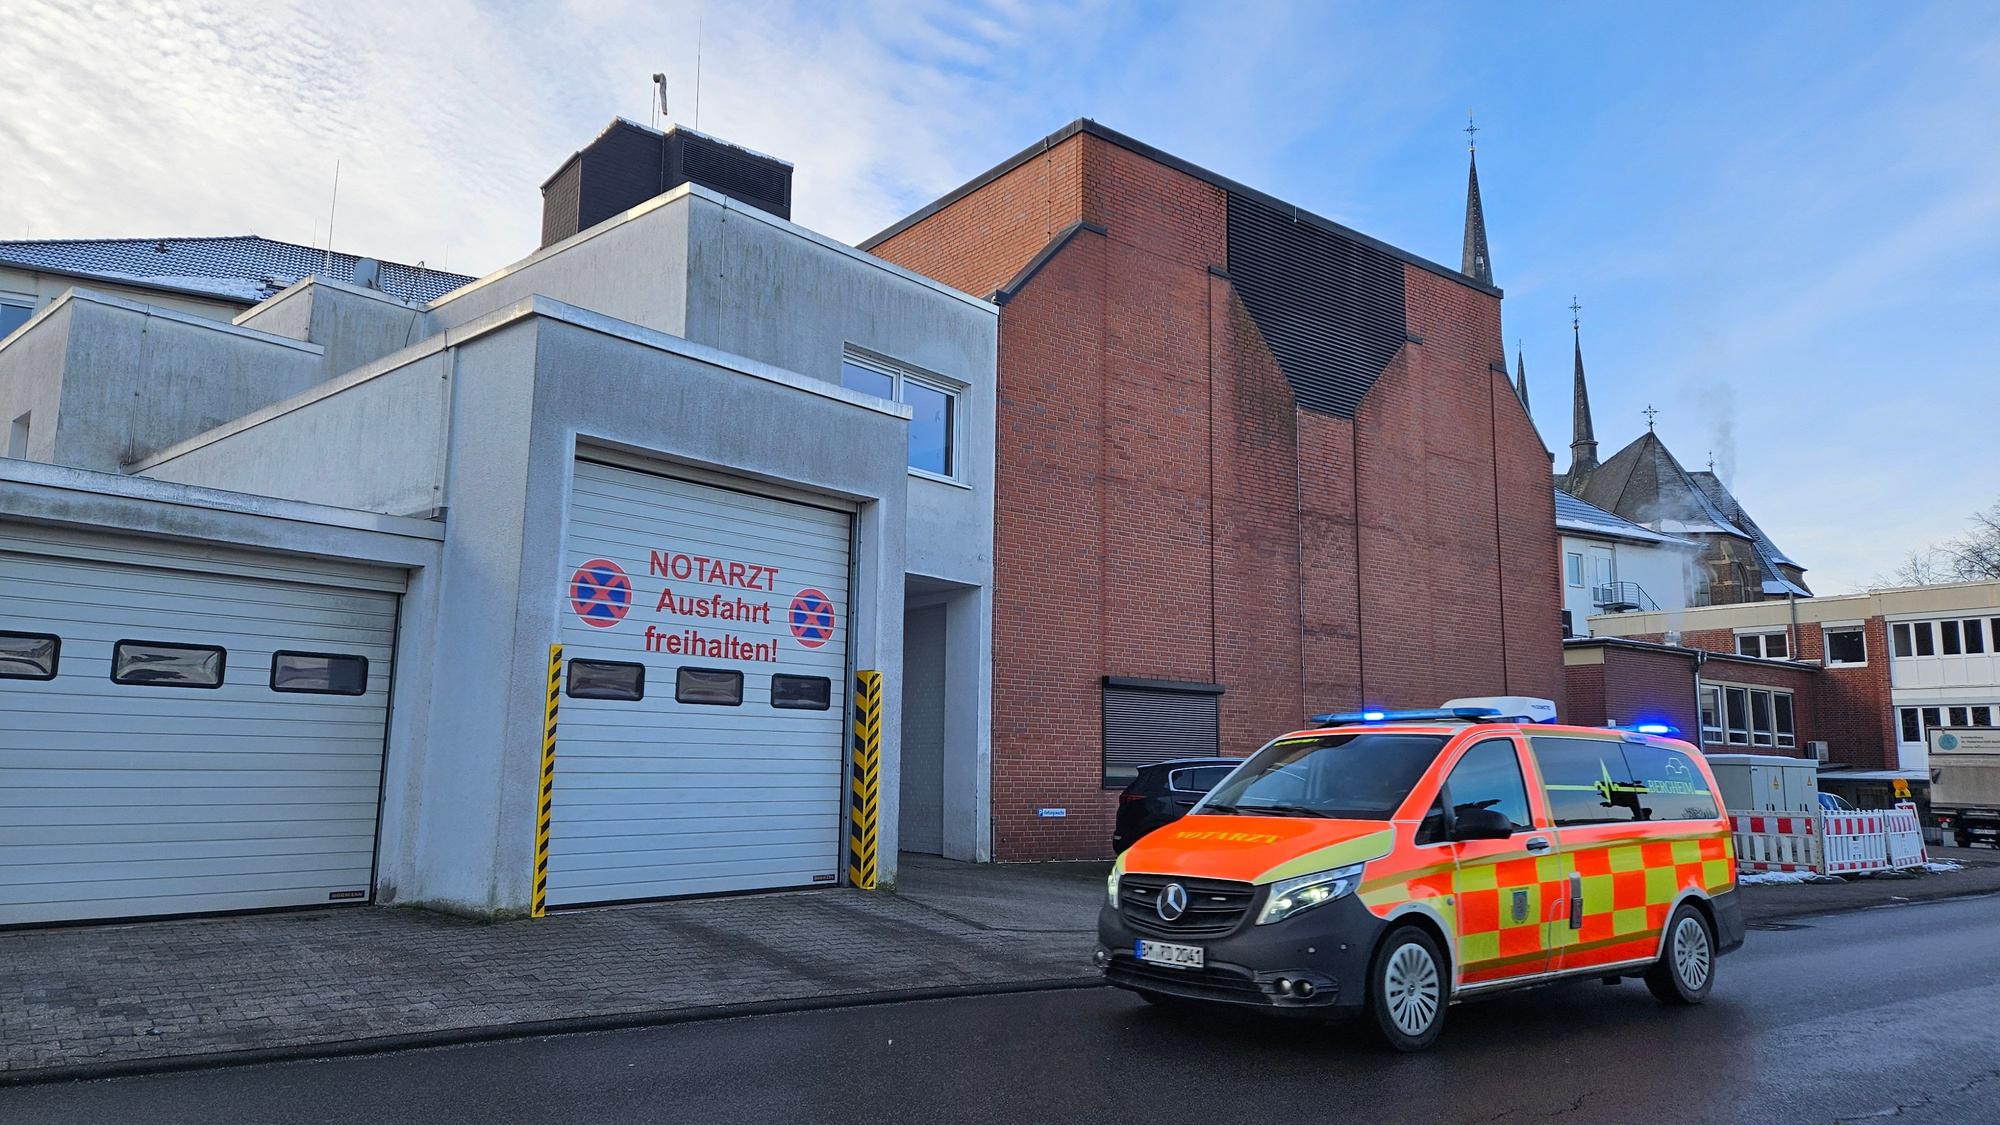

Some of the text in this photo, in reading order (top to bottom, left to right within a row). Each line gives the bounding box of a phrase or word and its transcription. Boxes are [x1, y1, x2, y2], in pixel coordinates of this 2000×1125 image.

[650, 550, 779, 592] NOTARZT
[655, 588, 770, 624] Ausfahrt
[645, 625, 778, 662] freihalten!
[1648, 780, 1696, 795] BERGHEIM
[1171, 831, 1283, 844] NOTARZT
